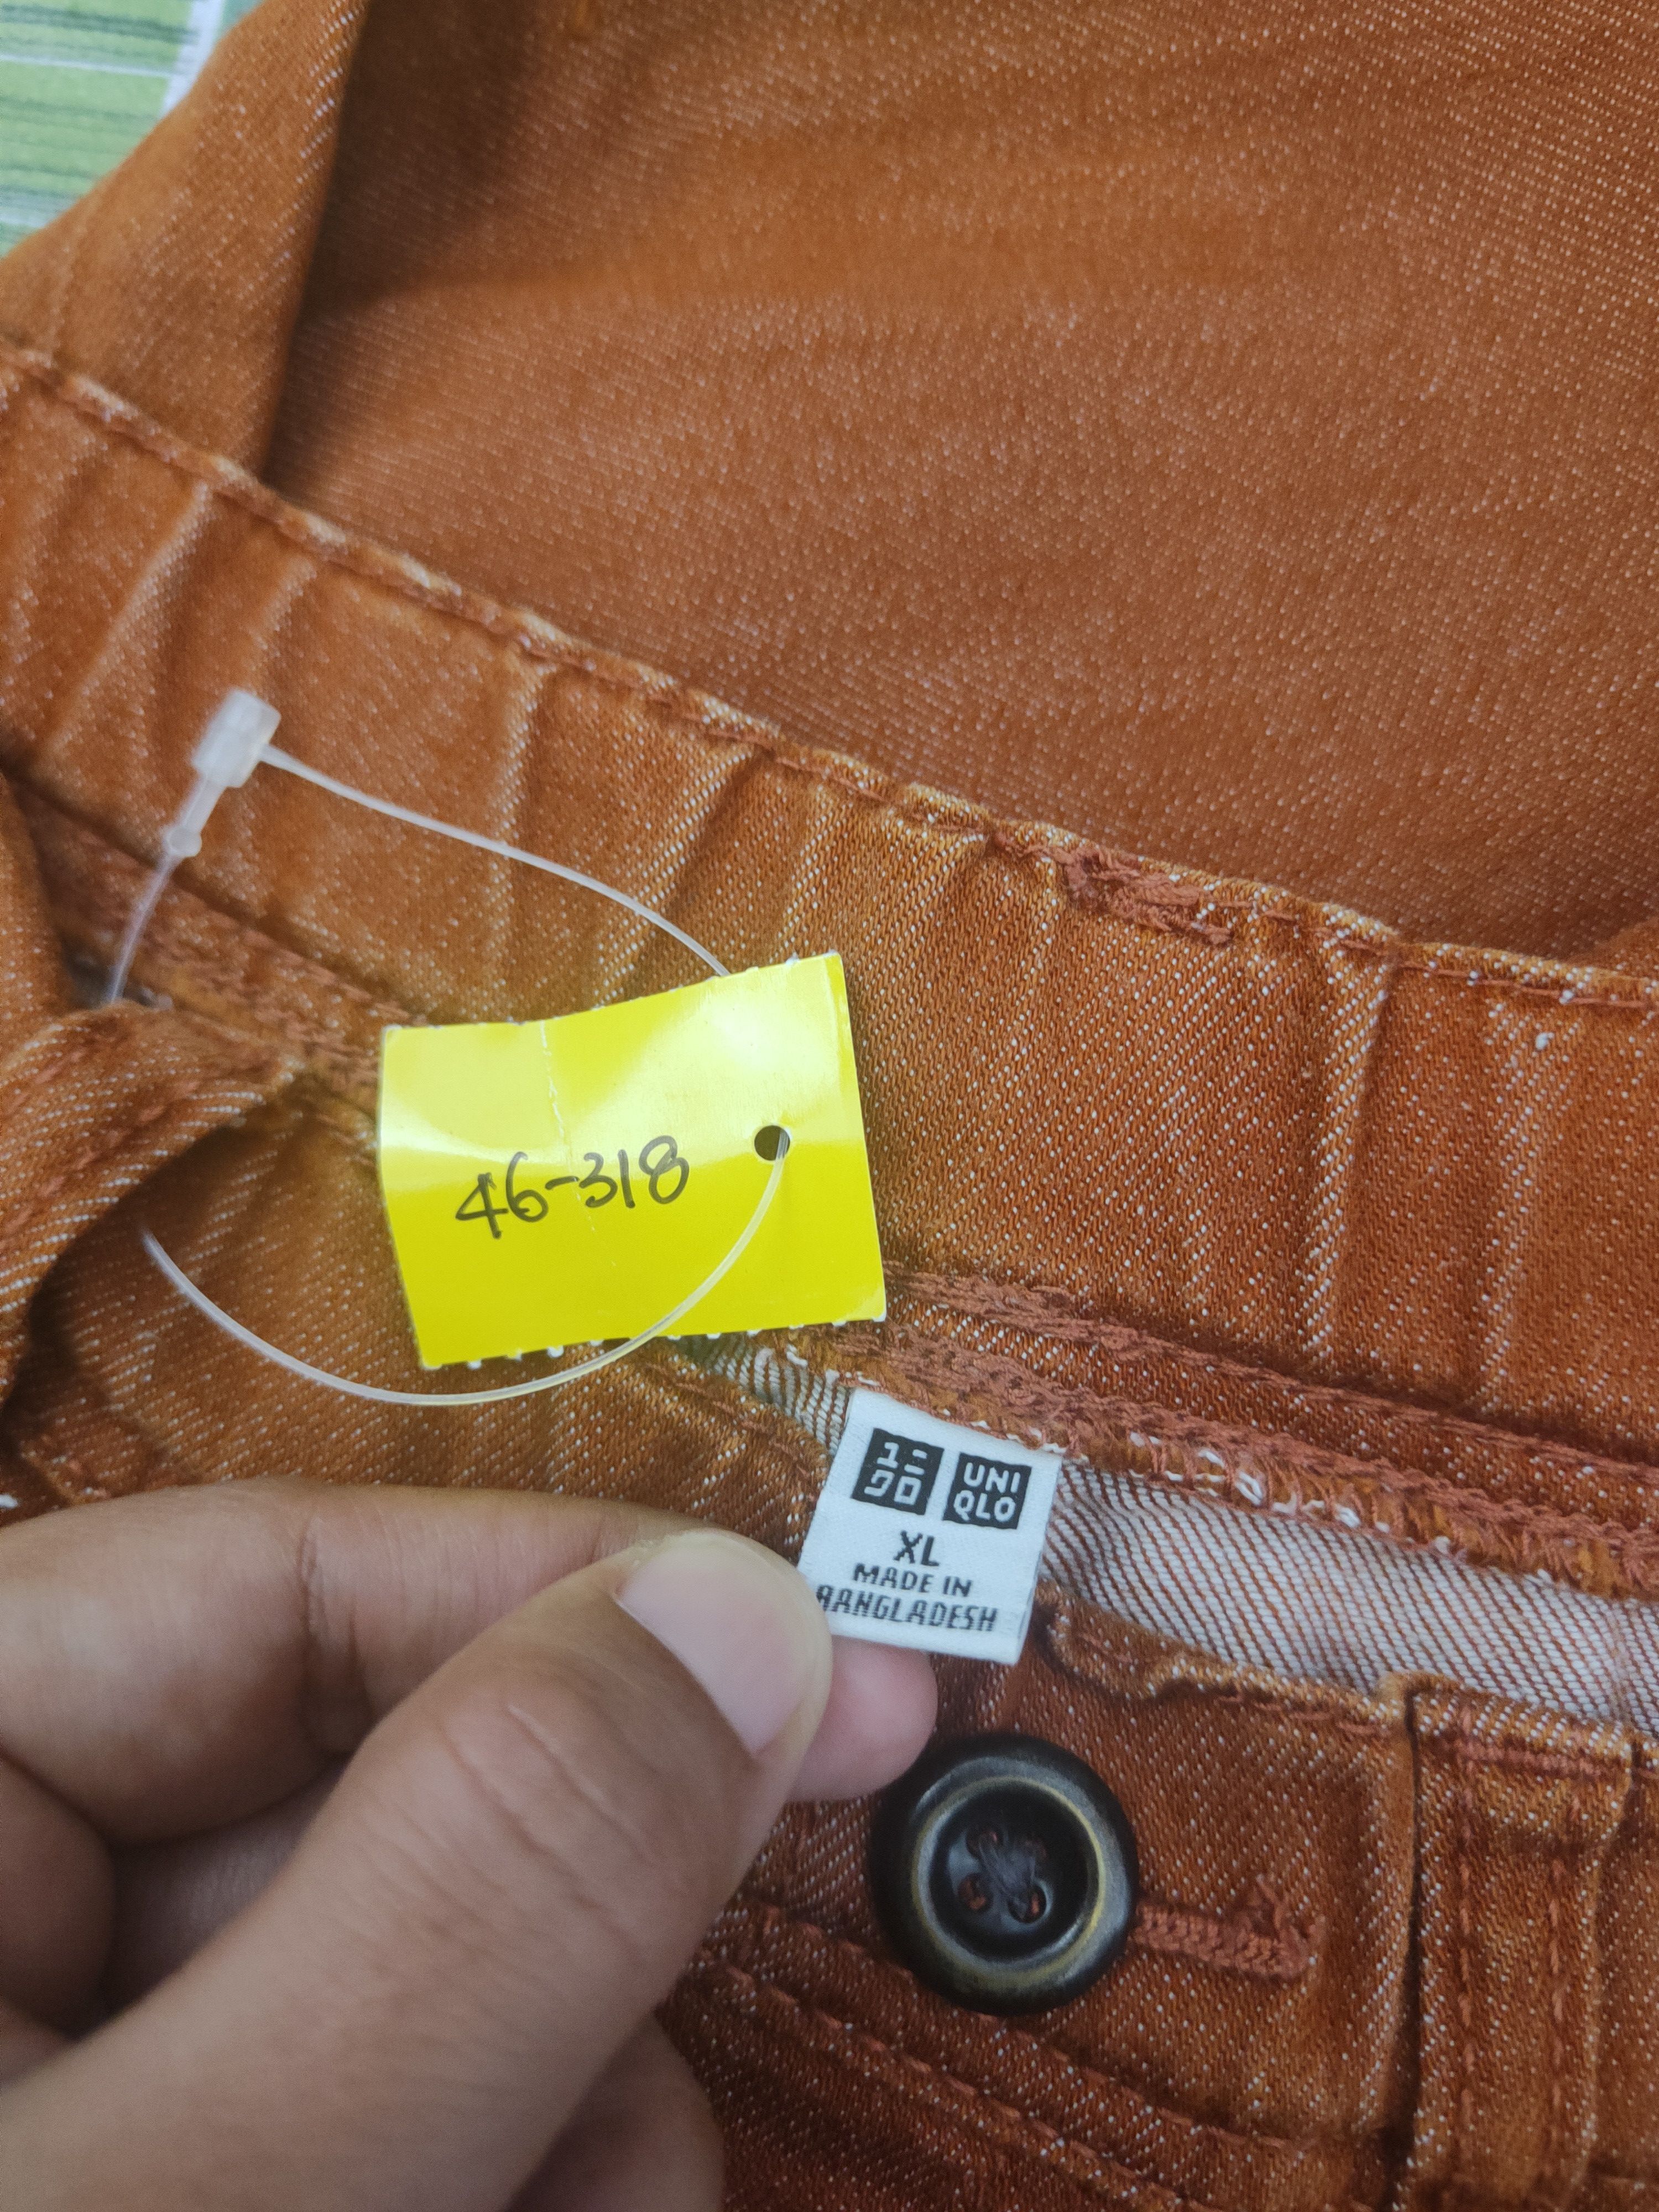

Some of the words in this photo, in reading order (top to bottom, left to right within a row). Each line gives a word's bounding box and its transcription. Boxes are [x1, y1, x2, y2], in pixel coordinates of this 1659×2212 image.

[455, 1135, 689, 1239] 46-318
[963, 1463, 1021, 1494] UNI
[953, 1490, 1016, 1522] QLO
[893, 1530, 940, 1566] XL
[853, 1563, 935, 1593] MADE
[943, 1575, 973, 1598] IN
